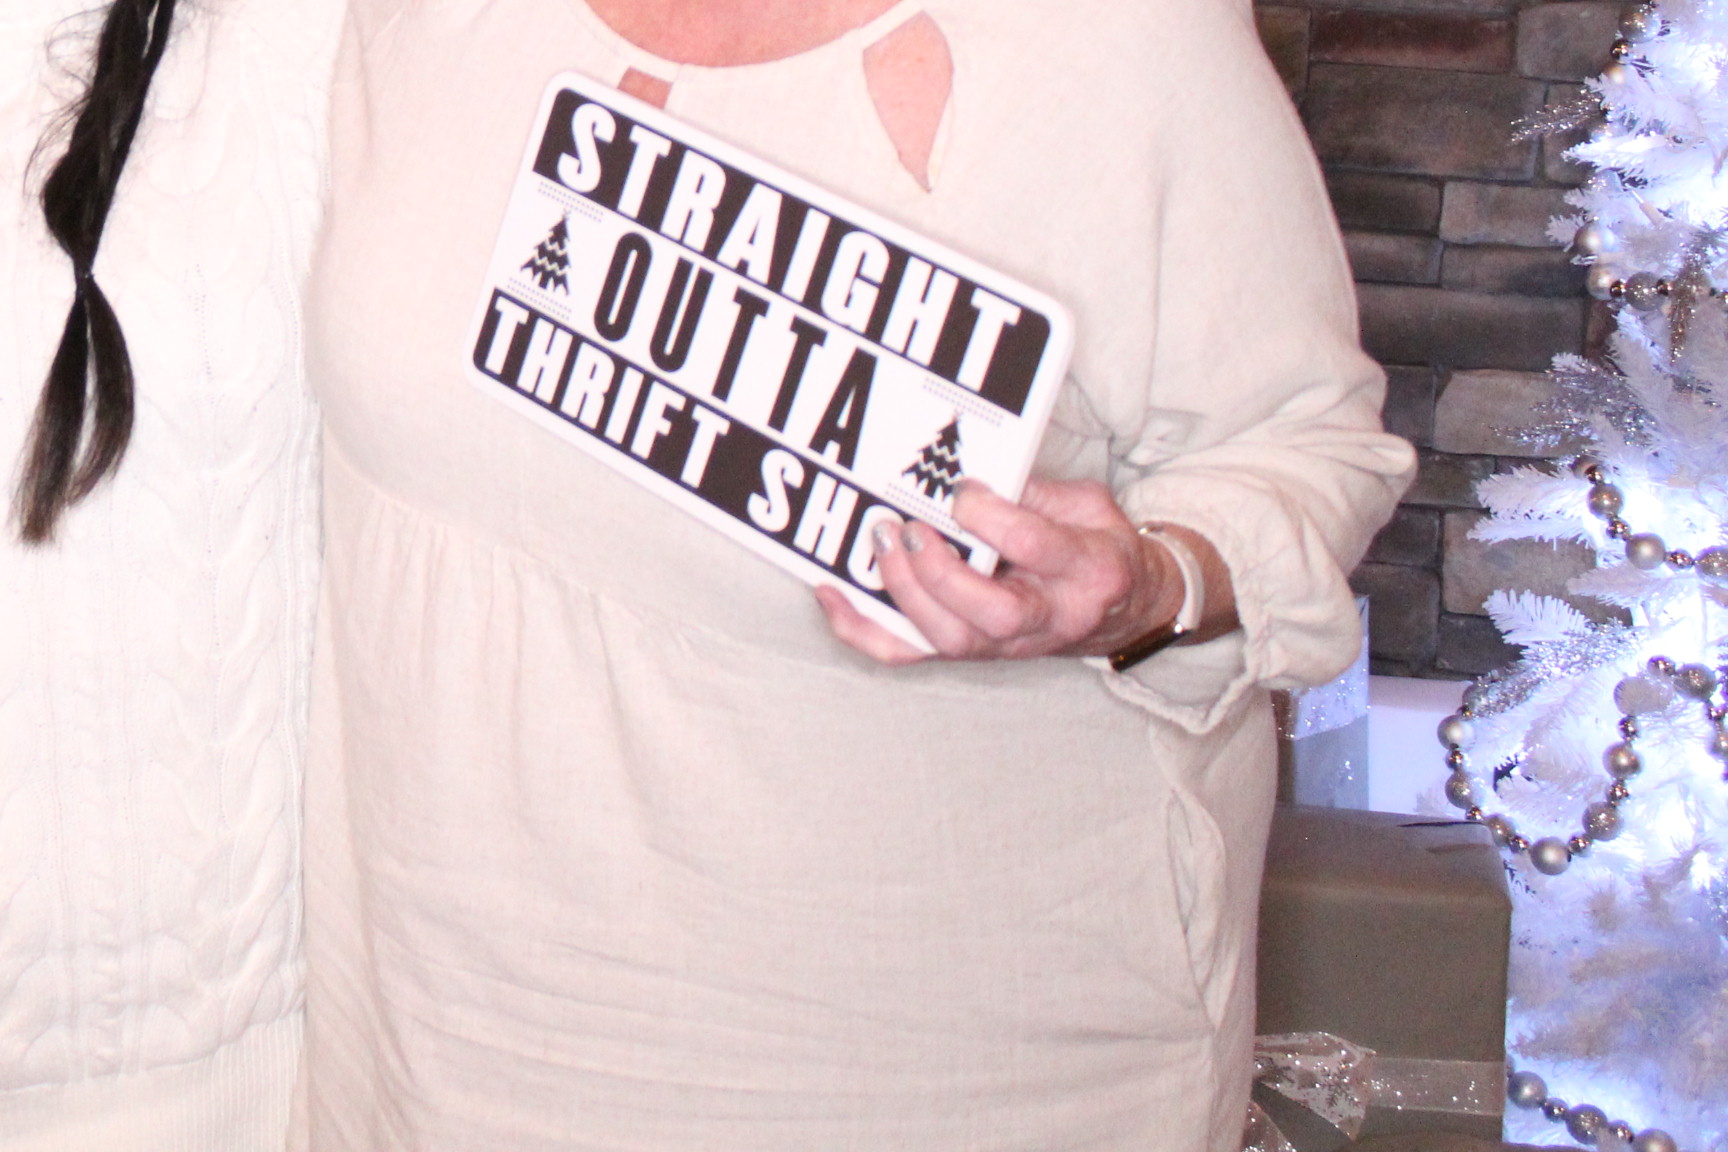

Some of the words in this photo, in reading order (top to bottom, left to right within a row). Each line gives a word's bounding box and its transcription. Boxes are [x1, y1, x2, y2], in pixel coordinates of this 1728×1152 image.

[557, 103, 1021, 392] STRAIGHT
[594, 232, 878, 471] OUTTA
[484, 296, 729, 489] THRIFT
[747, 448, 960, 591] SHO
